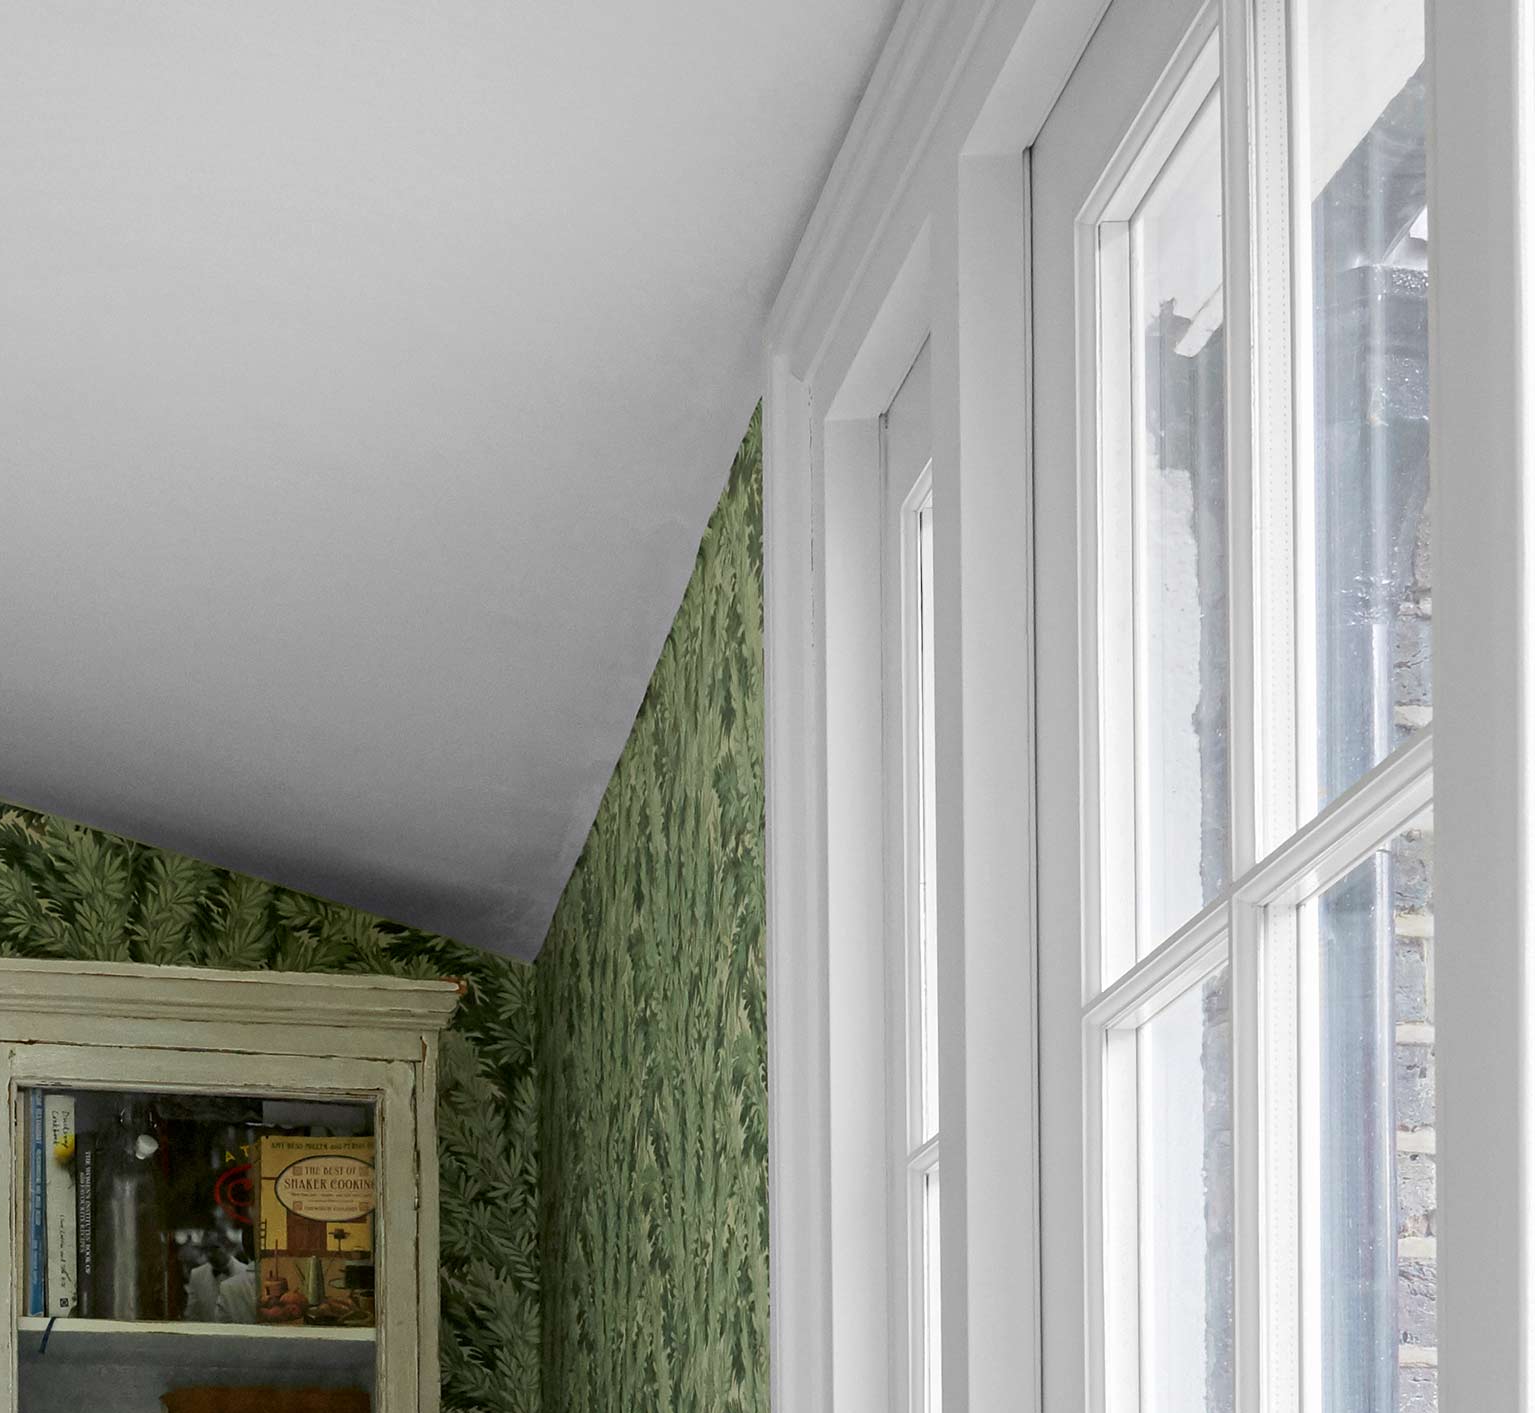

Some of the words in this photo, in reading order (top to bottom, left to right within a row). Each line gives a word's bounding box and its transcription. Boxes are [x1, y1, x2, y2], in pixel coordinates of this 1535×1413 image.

[304, 1166, 320, 1175] THE
[322, 1166, 344, 1175] BEST
[346, 1166, 357, 1175] OF
[284, 1179, 327, 1190] SHAKER
